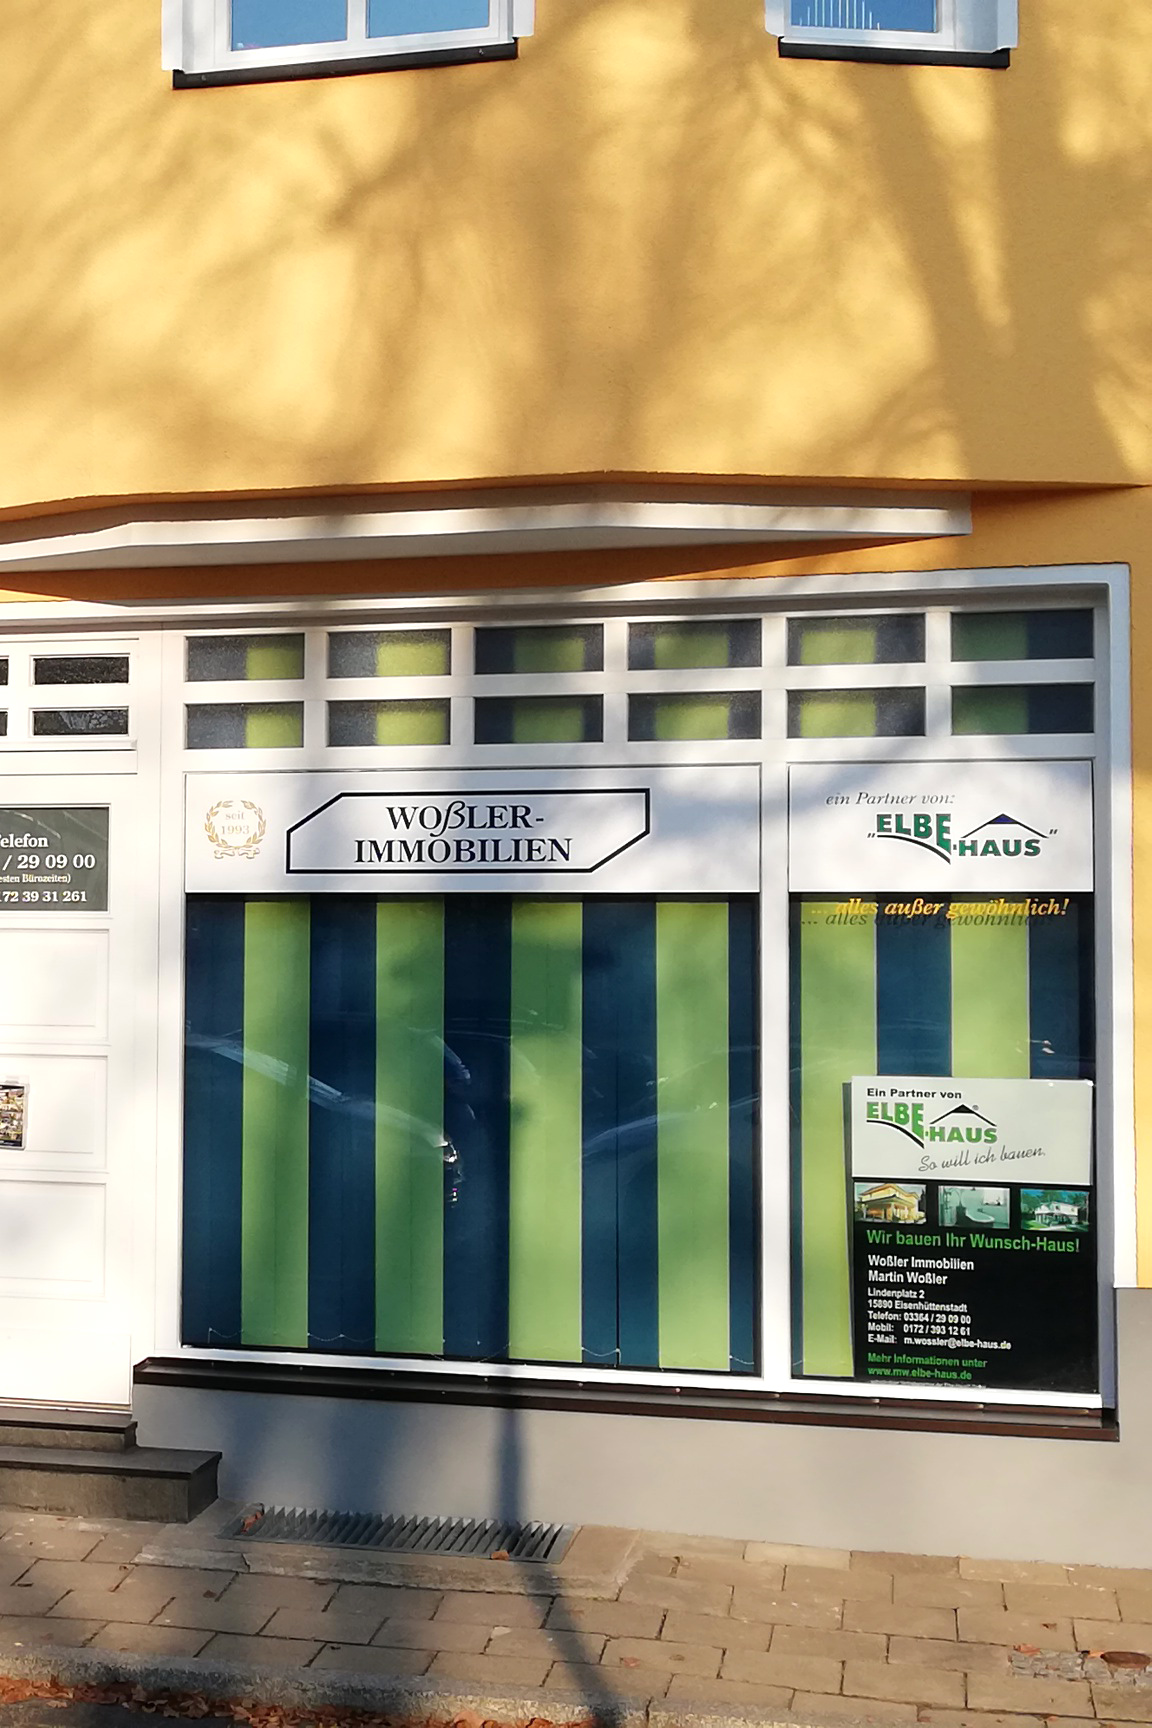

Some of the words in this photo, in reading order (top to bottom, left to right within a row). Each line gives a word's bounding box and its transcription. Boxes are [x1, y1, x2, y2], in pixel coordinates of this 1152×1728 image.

[825, 793, 850, 805] ein
[855, 791, 916, 805] Partner
[921, 793, 956, 805] von:
[225, 810, 245, 820] seit
[386, 801, 545, 837] WOßLER-
[221, 825, 250, 835] 1993
[353, 837, 573, 865] IMMOBILIEN
[2, 855, 13, 871] /
[17, 854, 40, 869] 29
[45, 854, 68, 869] 09
[72, 854, 96, 869] 00
[22, 873, 71, 884] Bürozeiten)
[22, 891, 39, 902] 39
[42, 891, 58, 902] 31
[62, 891, 87, 902] 261
[835, 898, 879, 915] alles
[884, 898, 944, 918] außer
[945, 898, 1070, 918] gewöhnlich!
[867, 1088, 886, 1097] Ein
[890, 1088, 937, 1098] Partner
[940, 1091, 962, 1099] von
[866, 1101, 924, 1140] ELBE
[918, 1155, 938, 1172] So
[942, 1150, 970, 1169] will
[974, 1146, 996, 1164] ich
[866, 1229, 893, 1245] Wir
[896, 1230, 941, 1247] bauen
[946, 1233, 966, 1248] Ihr
[970, 1233, 1080, 1253] Wunsch-Haus!
[868, 1255, 909, 1268] Woßler
[911, 1257, 975, 1271] Immobilien
[868, 1270, 904, 1283] Martin
[906, 1271, 948, 1285] Woßler
[867, 1287, 917, 1300] Lindenplatz
[919, 1289, 925, 1299] 2
[868, 1299, 893, 1309] 15890
[894, 1300, 968, 1313] Eisenhüttenstadt
[867, 1311, 902, 1321] Telefon:
[903, 1313, 929, 1322] 03364
[936, 1314, 946, 1323] 29
[948, 1314, 959, 1324] 09
[960, 1315, 971, 1324] 00
[867, 1322, 894, 1332] Mobil:
[903, 1324, 924, 1333] 0172
[930, 1325, 946, 1335] 393
[948, 1326, 959, 1336] 12
[960, 1327, 970, 1336] 61
[867, 1334, 898, 1344] E-Mail:
[867, 1353, 891, 1363] Mehr
[893, 1354, 960, 1366] Informationen
[961, 1357, 988, 1368] unter
